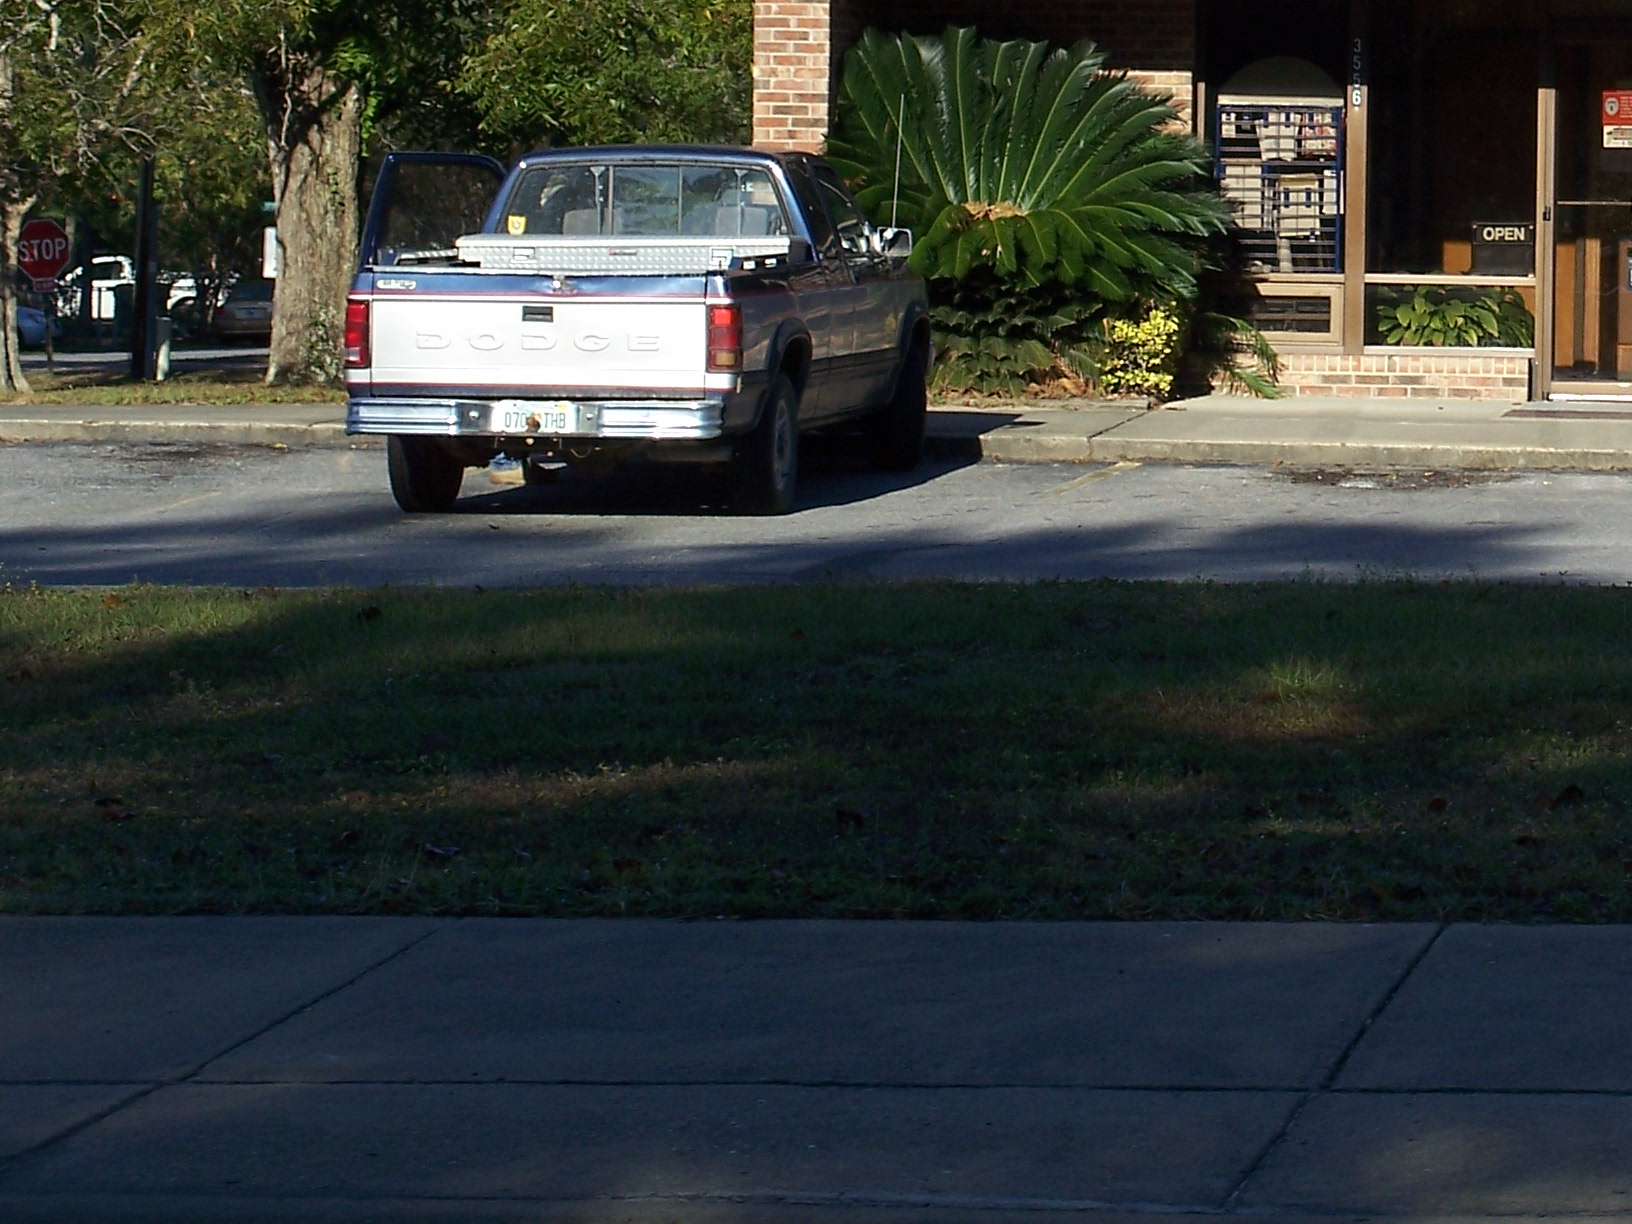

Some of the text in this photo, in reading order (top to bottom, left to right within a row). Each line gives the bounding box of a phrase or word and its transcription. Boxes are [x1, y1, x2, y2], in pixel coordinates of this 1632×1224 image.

[1352, 37, 1362, 106] 3556
[1482, 226, 1526, 242] OPEN
[18, 237, 67, 262] STOP
[416, 329, 661, 353] DODGE
[543, 412, 567, 429] THB
